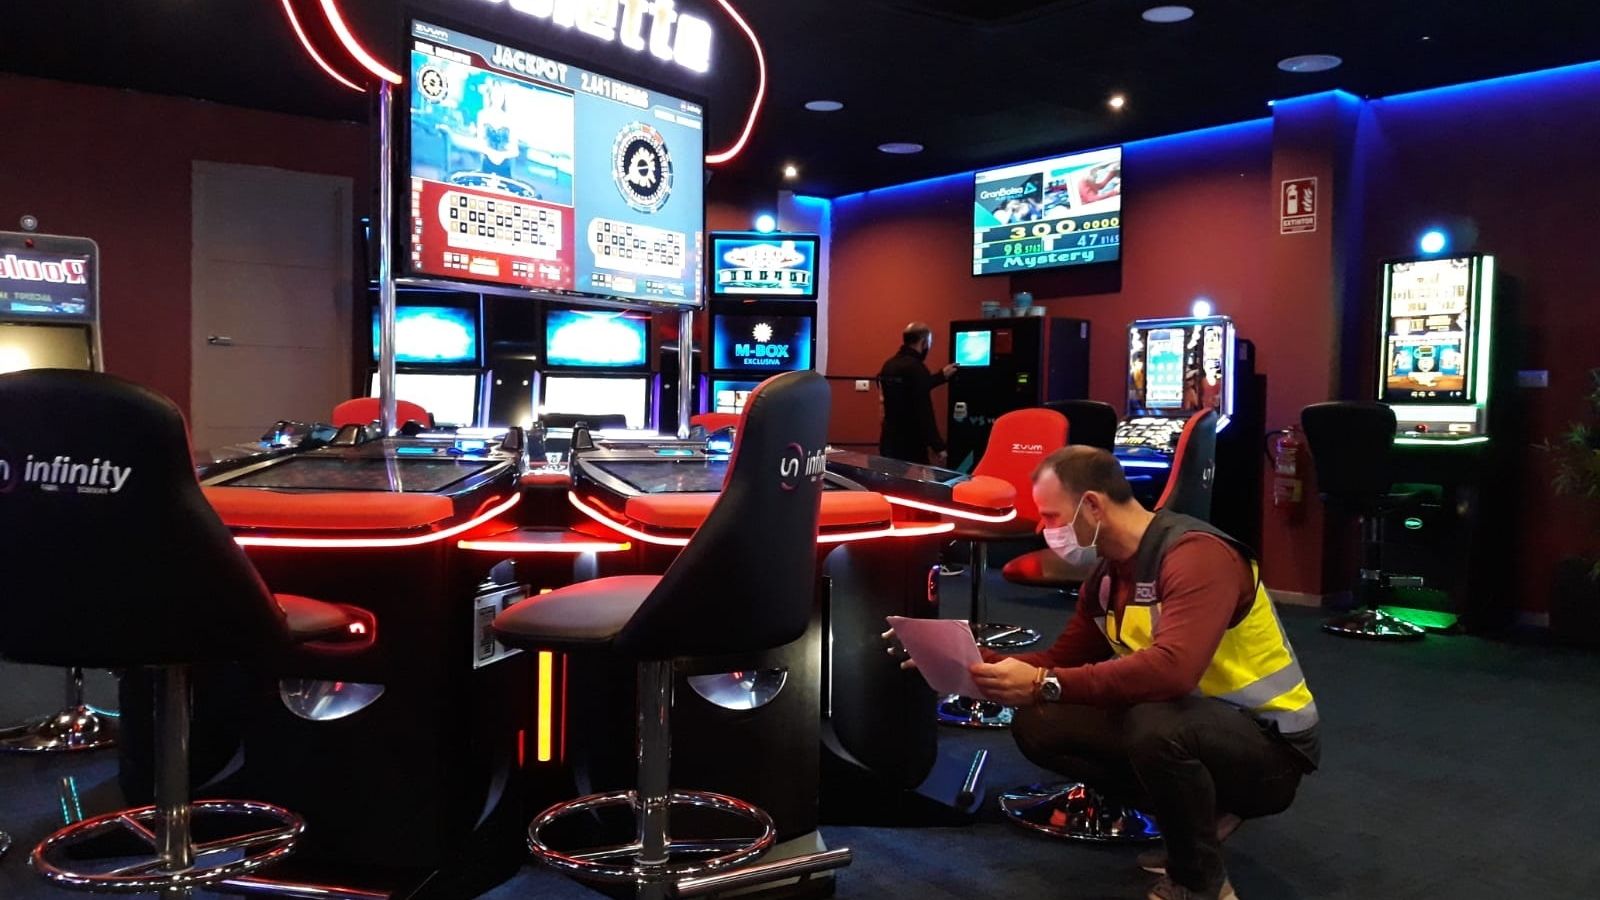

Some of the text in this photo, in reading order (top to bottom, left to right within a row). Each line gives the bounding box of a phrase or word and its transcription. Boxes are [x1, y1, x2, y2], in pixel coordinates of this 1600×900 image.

[492, 44, 567, 85] JACKPOT
[1003, 250, 1095, 268] Mystery
[735, 344, 790, 358] M-BOX
[743, 358, 781, 366] EXCLUSIVA
[24, 454, 132, 493] infinity
